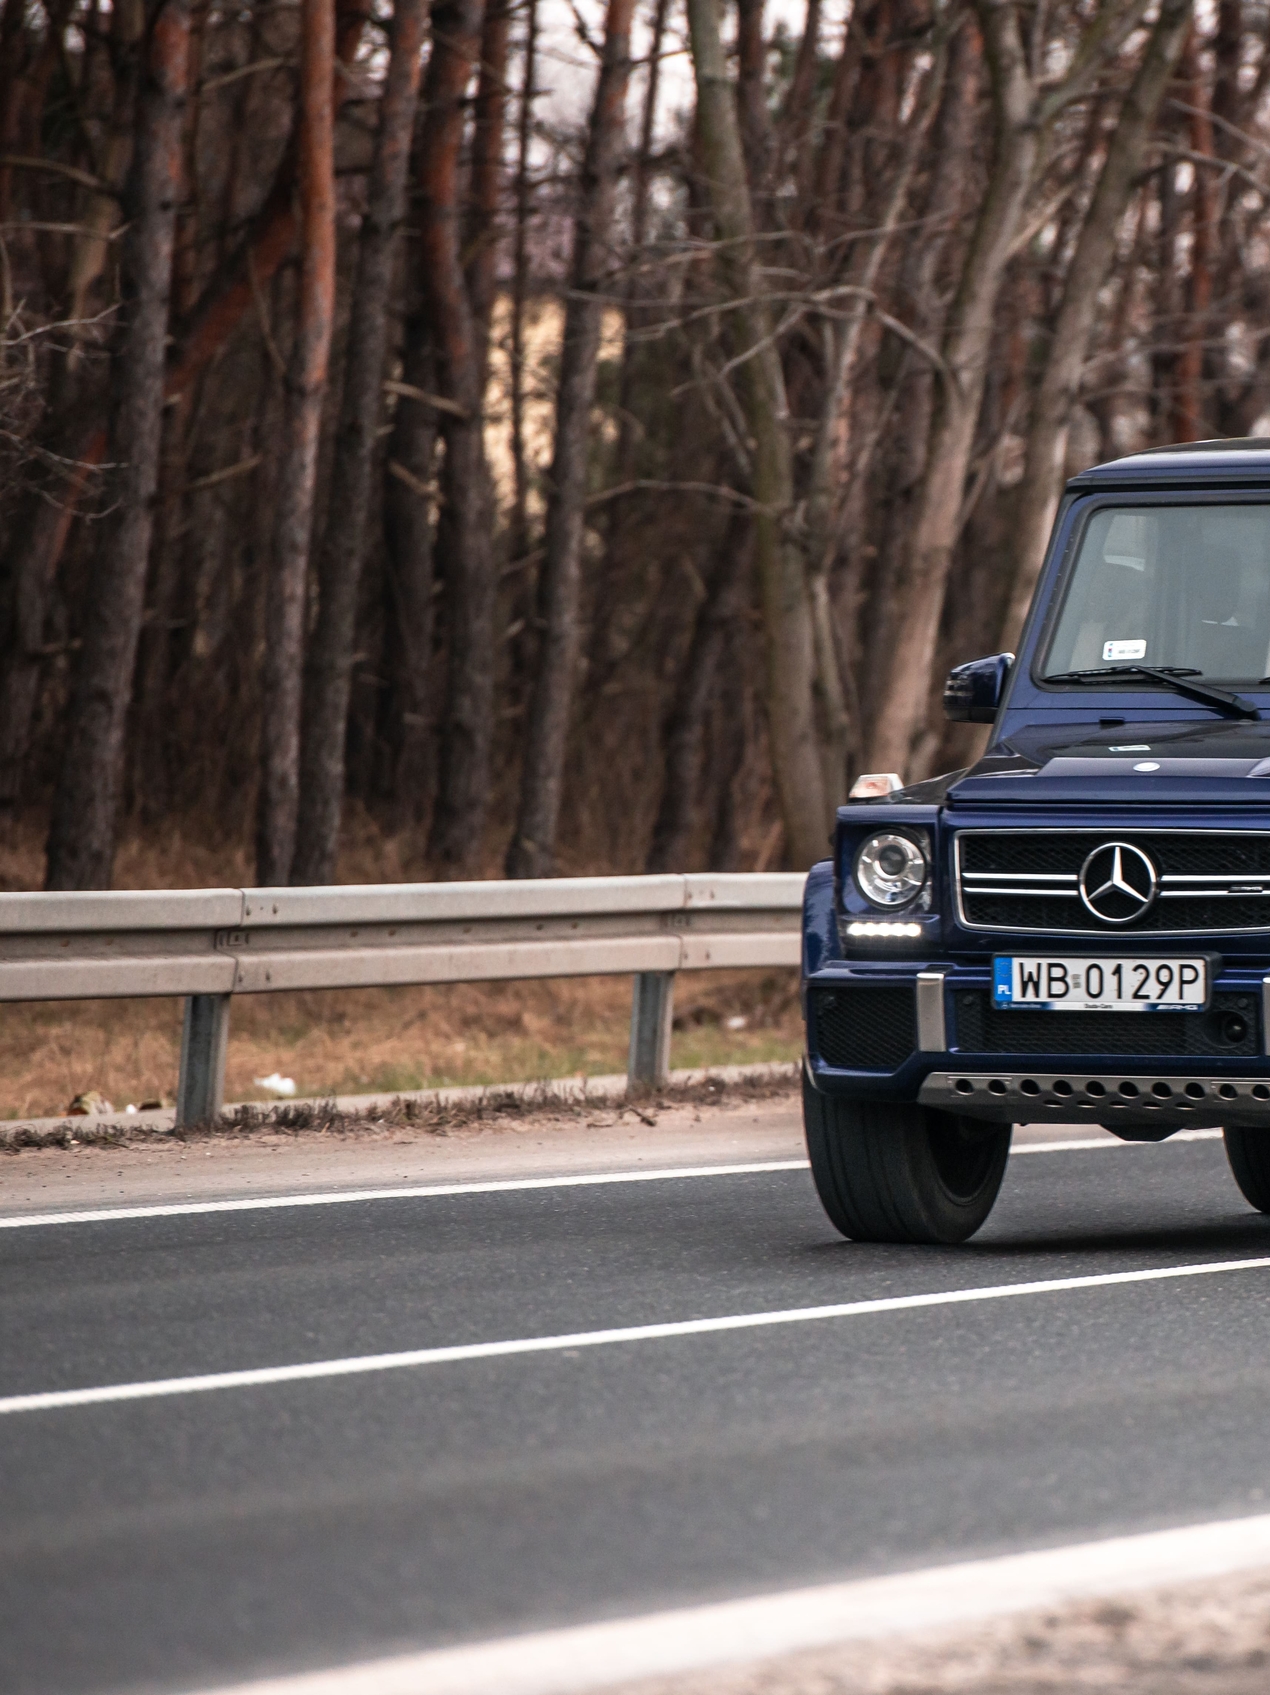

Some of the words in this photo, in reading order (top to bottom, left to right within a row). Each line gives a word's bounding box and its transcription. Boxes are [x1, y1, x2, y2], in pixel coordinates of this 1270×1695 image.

[998, 985, 1011, 994] PL
[1019, 962, 1069, 998] WB
[1085, 963, 1199, 1000] 0129P
